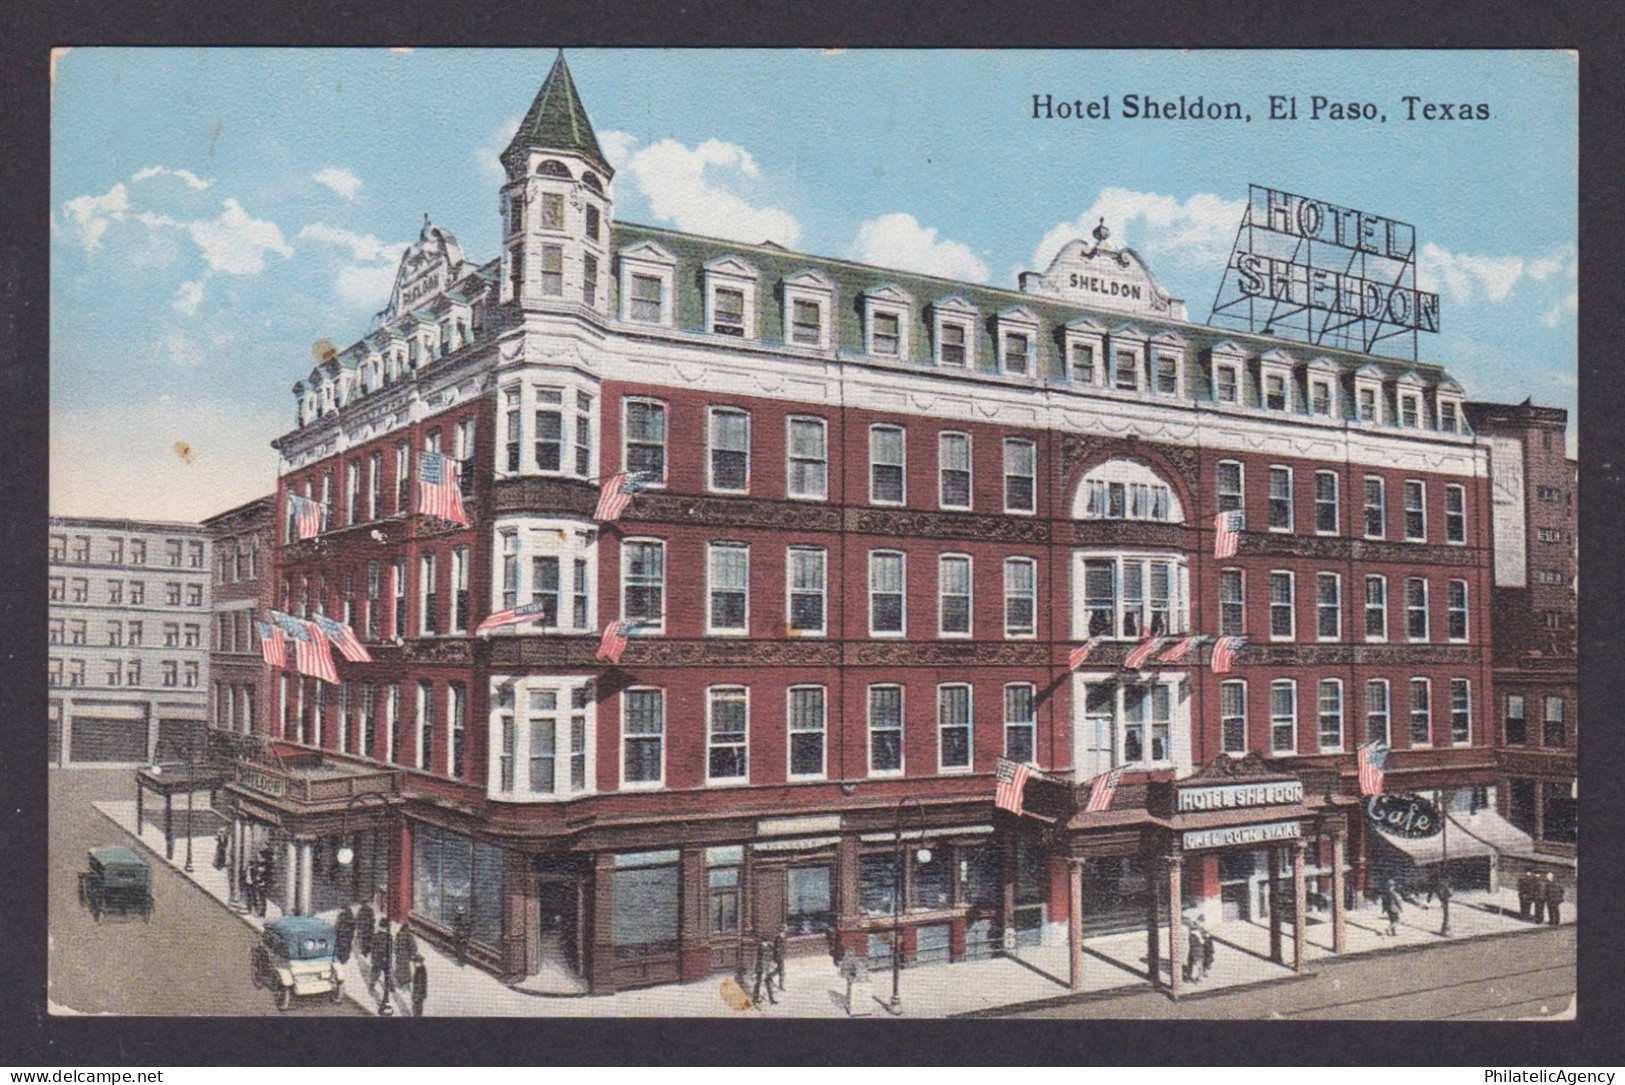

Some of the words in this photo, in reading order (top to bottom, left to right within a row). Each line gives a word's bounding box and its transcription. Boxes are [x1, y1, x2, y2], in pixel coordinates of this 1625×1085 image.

[1266, 187, 1413, 262] HOTEL
[1069, 273, 1141, 300] SHELDON
[1236, 250, 1440, 332] SHELDON
[1182, 789, 1230, 811] HOTEL
[1233, 786, 1302, 807] SHELDON
[1367, 794, 1431, 832] Cafe
